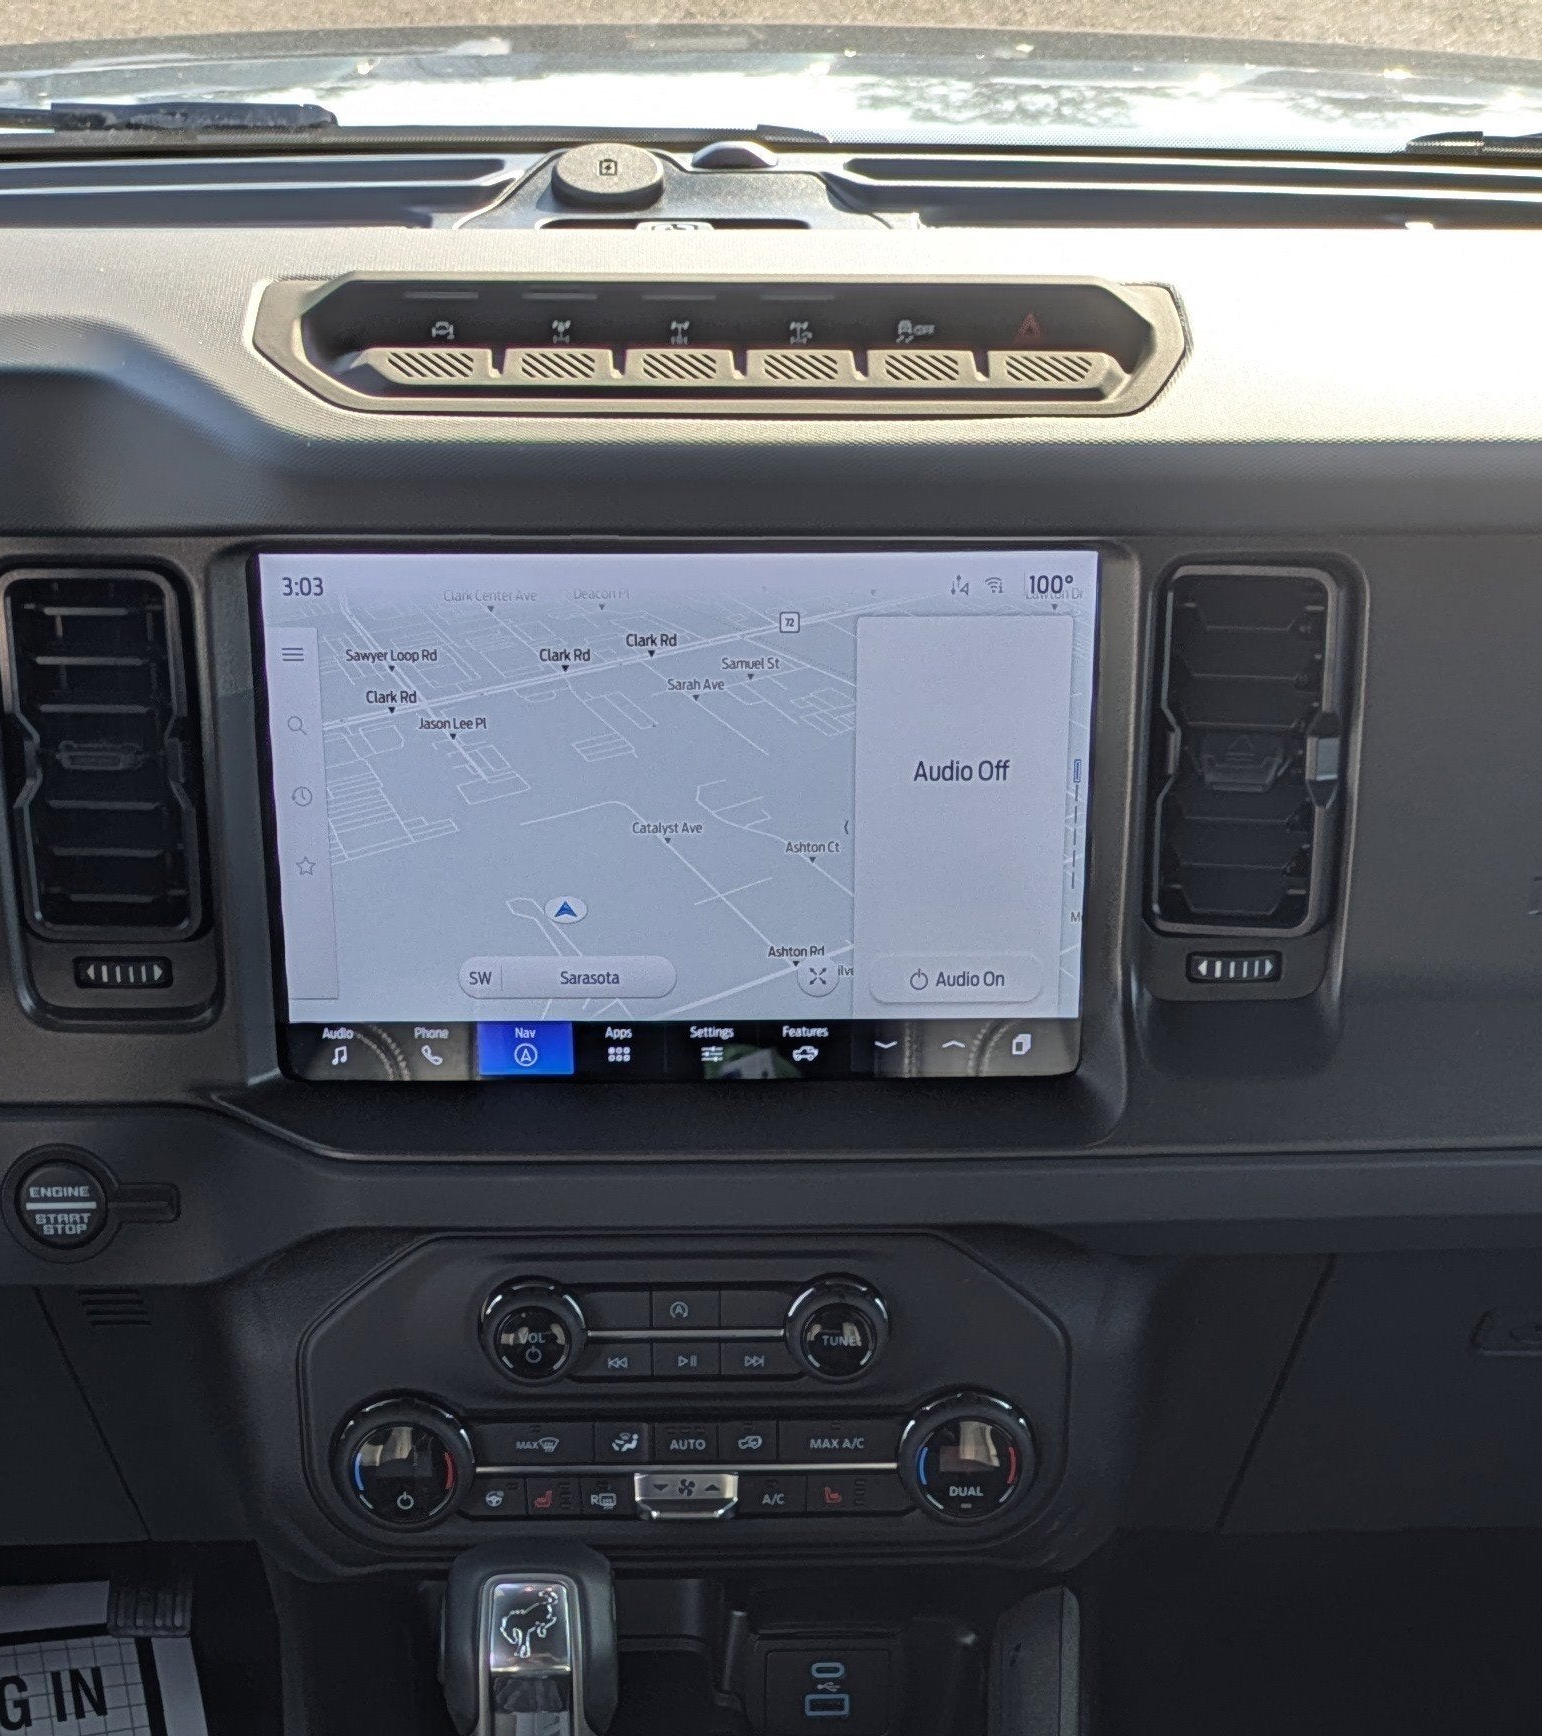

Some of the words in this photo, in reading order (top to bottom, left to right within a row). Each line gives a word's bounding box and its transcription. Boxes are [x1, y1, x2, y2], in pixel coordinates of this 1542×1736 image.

[282, 577, 324, 596] 3:03
[785, 617, 795, 627] 72
[626, 633, 656, 648] Clark
[658, 633, 677, 648] Rd
[346, 649, 389, 664] Sawyer
[391, 649, 417, 665] Loop
[419, 649, 437, 662] Rd
[539, 648, 569, 662] Clark
[572, 648, 591, 662] Rd
[722, 657, 763, 670] Samuel
[766, 657, 781, 670] St
[667, 678, 700, 691] Sarah
[703, 678, 725, 691] Ave
[366, 690, 396, 704] Clark
[398, 690, 417, 704] Rd
[419, 717, 451, 731] Jason
[453, 717, 473, 731] Lee
[476, 717, 487, 731] Pl
[914, 760, 972, 782] Audio
[978, 759, 1010, 782] Off
[632, 821, 678, 836] Catalyst
[680, 821, 703, 835] Ave
[785, 841, 825, 855] Ashton
[827, 841, 840, 855] Ct
[768, 945, 807, 959] Ashton
[469, 971, 492, 986] SW
[560, 970, 620, 986] Sarasota
[936, 971, 978, 988] Audio
[983, 971, 1005, 988] On
[322, 1026, 354, 1041] Audio
[414, 1026, 449, 1040] Phone
[515, 1027, 536, 1039] Nav
[605, 1026, 633, 1042] Apps
[689, 1026, 735, 1041] Settings
[782, 1026, 829, 1039] Features
[29, 1186, 90, 1198] ENGINE
[35, 1213, 91, 1225] START
[43, 1224, 87, 1235] STOP
[518, 1332, 546, 1345] VOL
[822, 1335, 860, 1347] TUNE
[516, 1440, 539, 1451] MAX
[669, 1439, 706, 1451] AUTO
[810, 1438, 839, 1450] MAX
[842, 1438, 865, 1451] A/C
[949, 1486, 984, 1498] DUAL
[762, 1493, 785, 1506] A/C
[50, 1666, 108, 1722] IN
